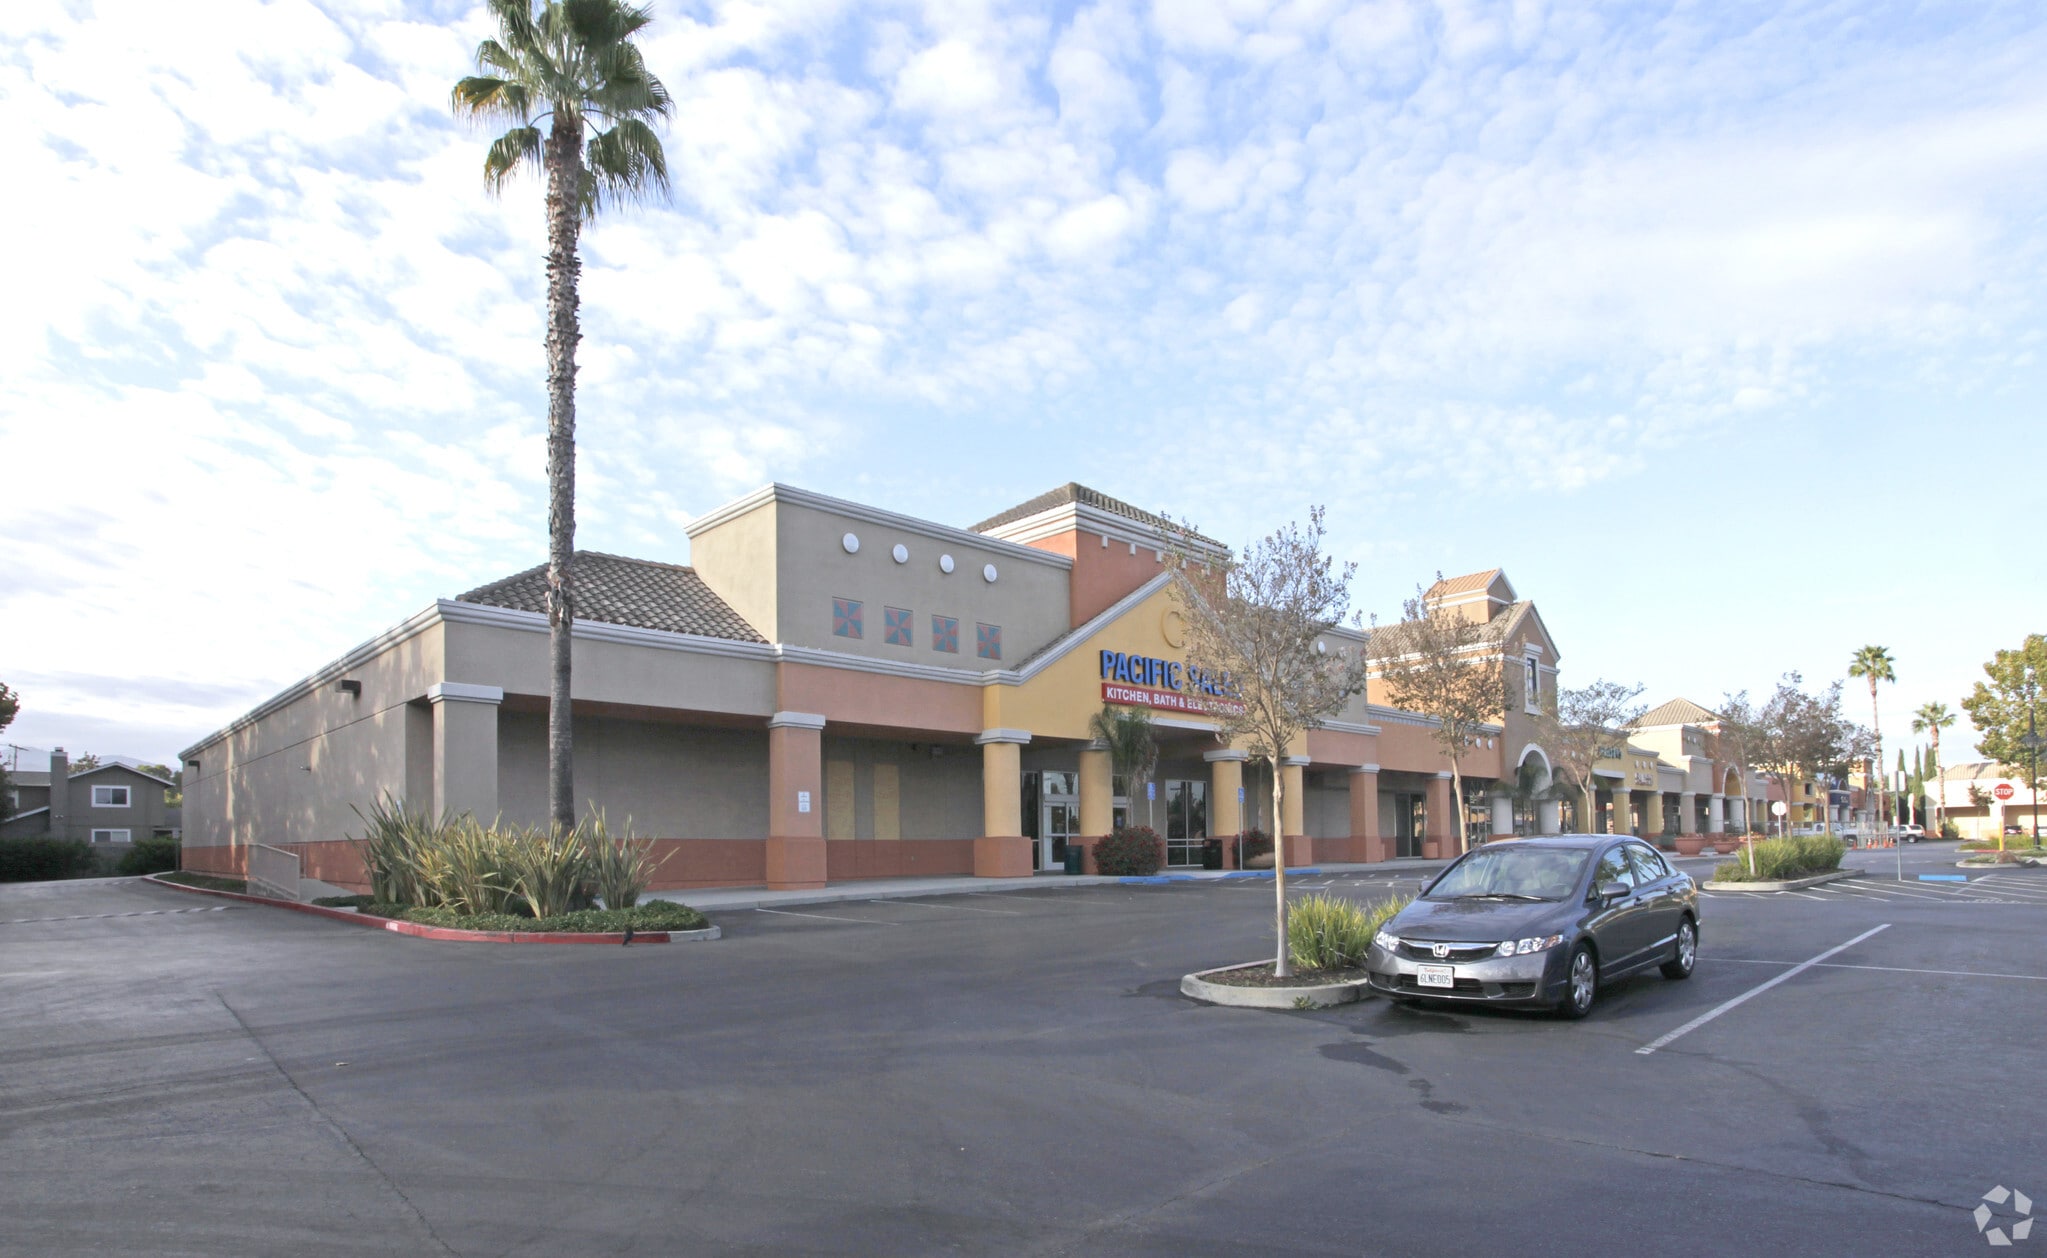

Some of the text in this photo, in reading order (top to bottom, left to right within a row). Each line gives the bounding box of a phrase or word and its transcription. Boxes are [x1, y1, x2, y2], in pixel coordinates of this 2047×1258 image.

[1100, 650, 1182, 690] PACIFIC
[1106, 686, 1152, 705] KITCHEN,
[1153, 693, 1177, 707] BATH
[1178, 697, 1185, 708] &
[1995, 788, 2013, 796] STOP
